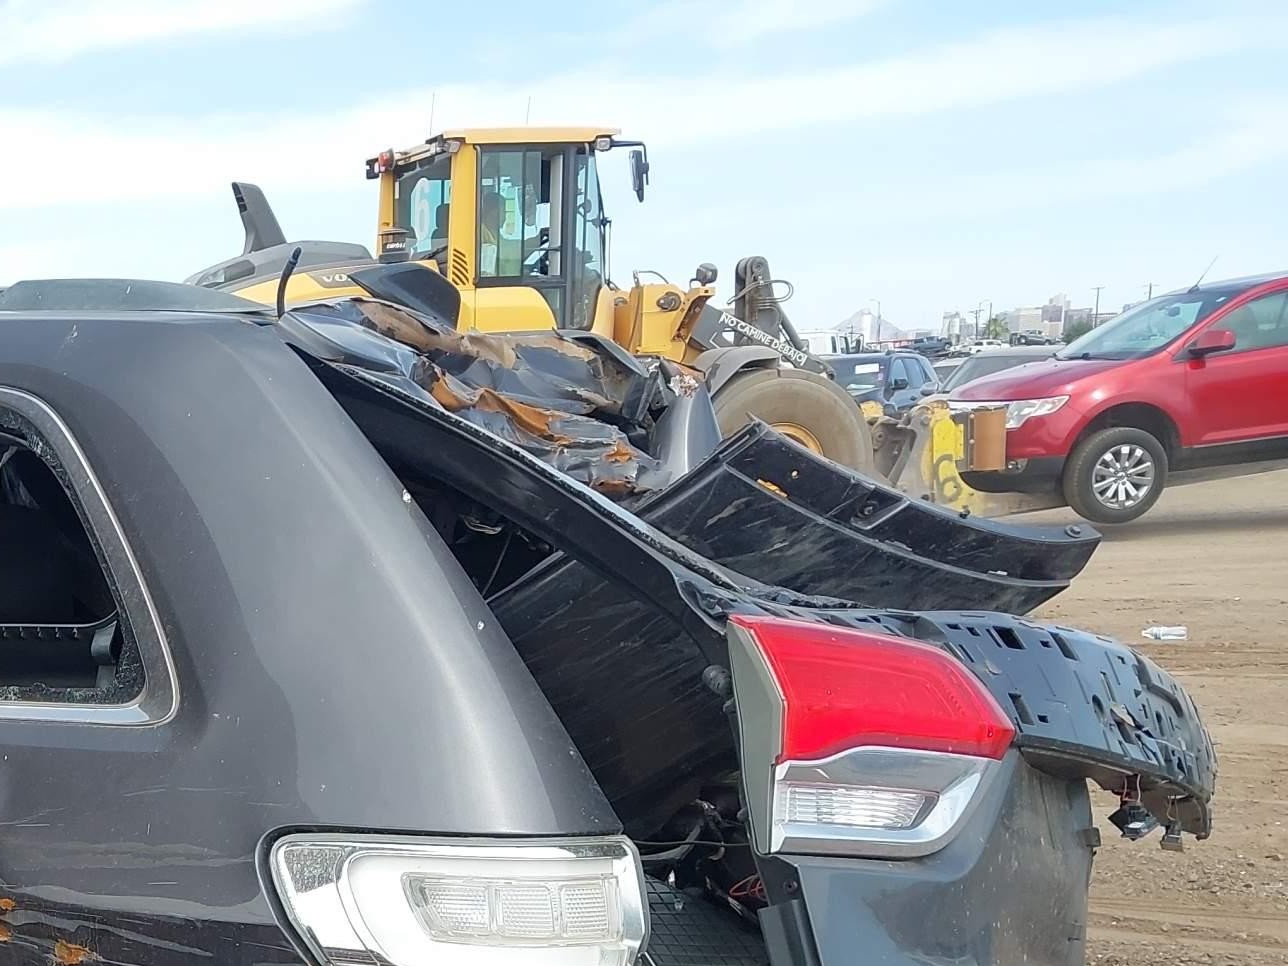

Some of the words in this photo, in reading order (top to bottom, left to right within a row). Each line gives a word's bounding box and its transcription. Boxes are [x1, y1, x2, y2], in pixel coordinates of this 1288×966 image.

[720, 313, 737, 327] NO
[737, 321, 773, 345] CAMINE
[772, 340, 805, 362] DEBAJO
